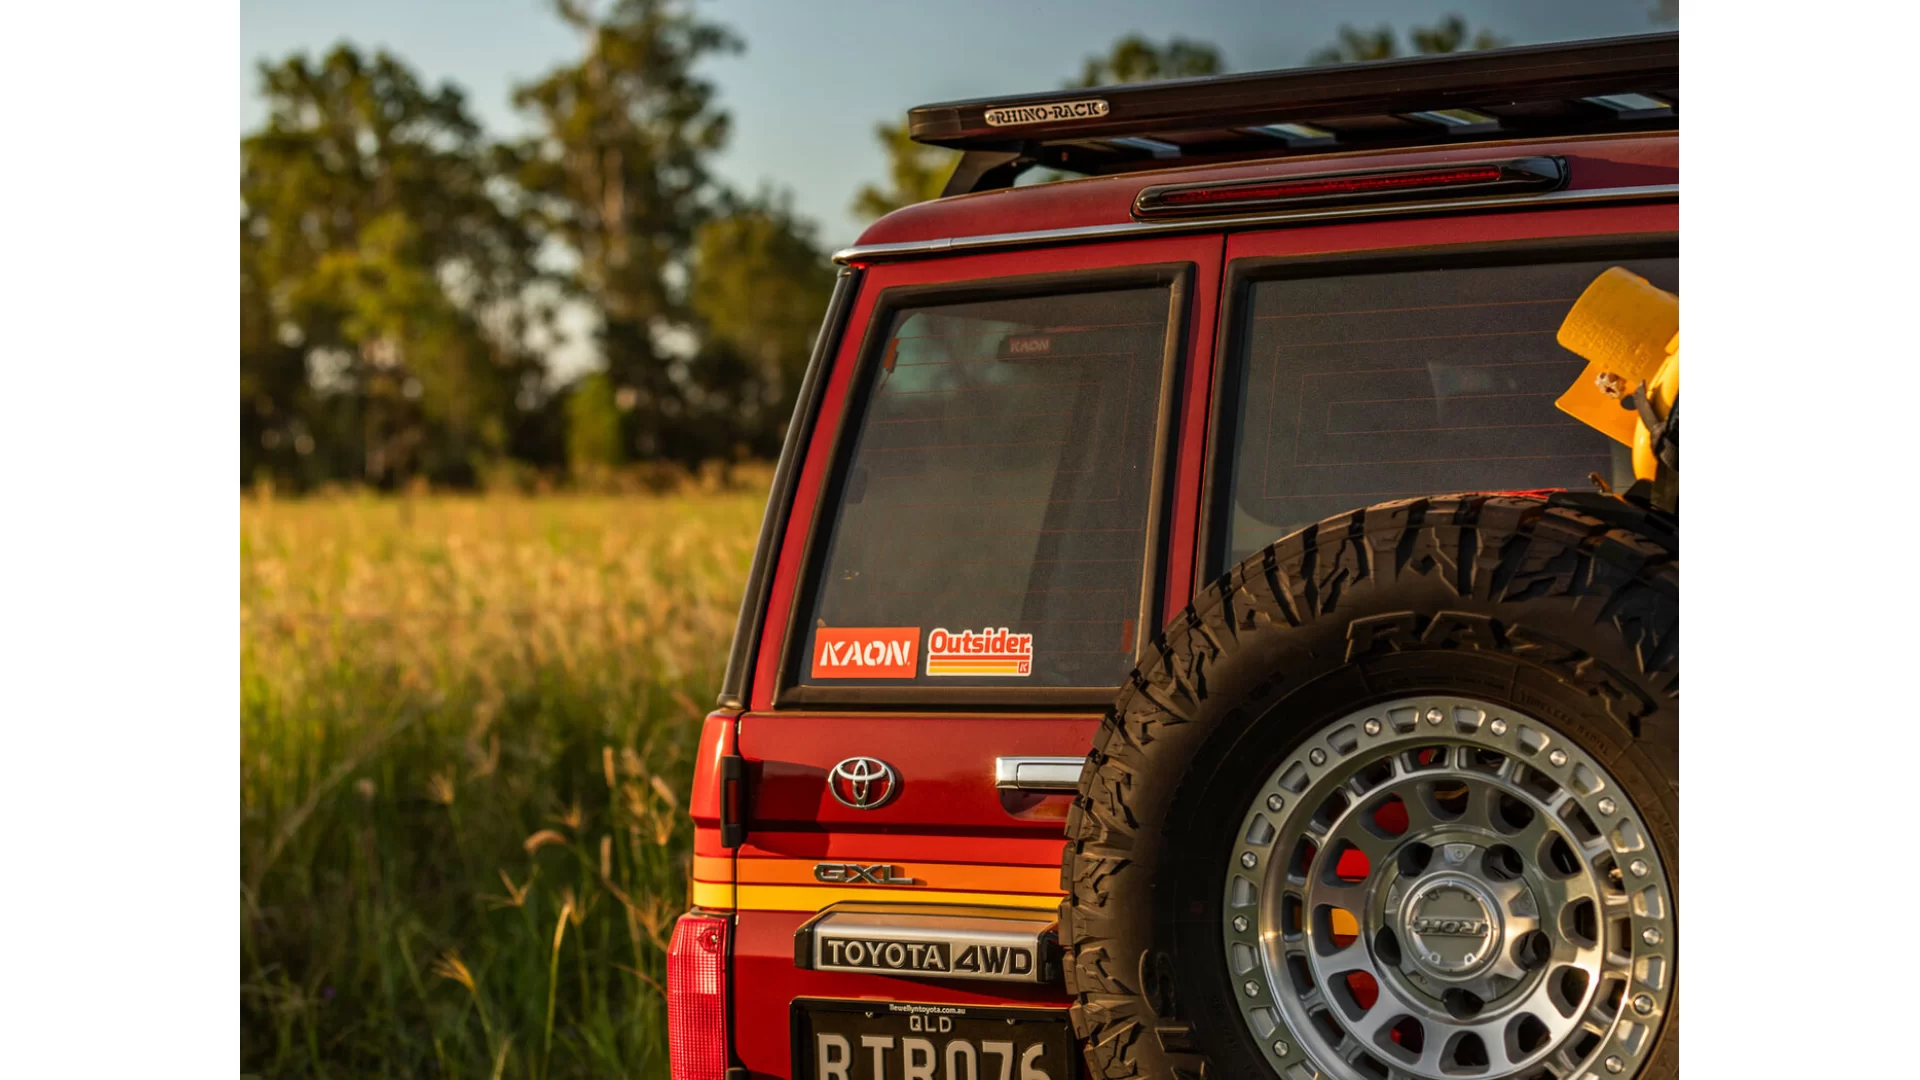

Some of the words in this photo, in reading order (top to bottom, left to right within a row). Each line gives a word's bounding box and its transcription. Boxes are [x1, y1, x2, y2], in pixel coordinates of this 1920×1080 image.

[994, 102, 1099, 124] RHINO-RACK
[1010, 339, 1049, 353] KAON
[813, 862, 914, 885] GXL
[827, 940, 946, 970] TOYOTA
[953, 944, 1034, 975] 4WD
[909, 1015, 952, 1033] QLD
